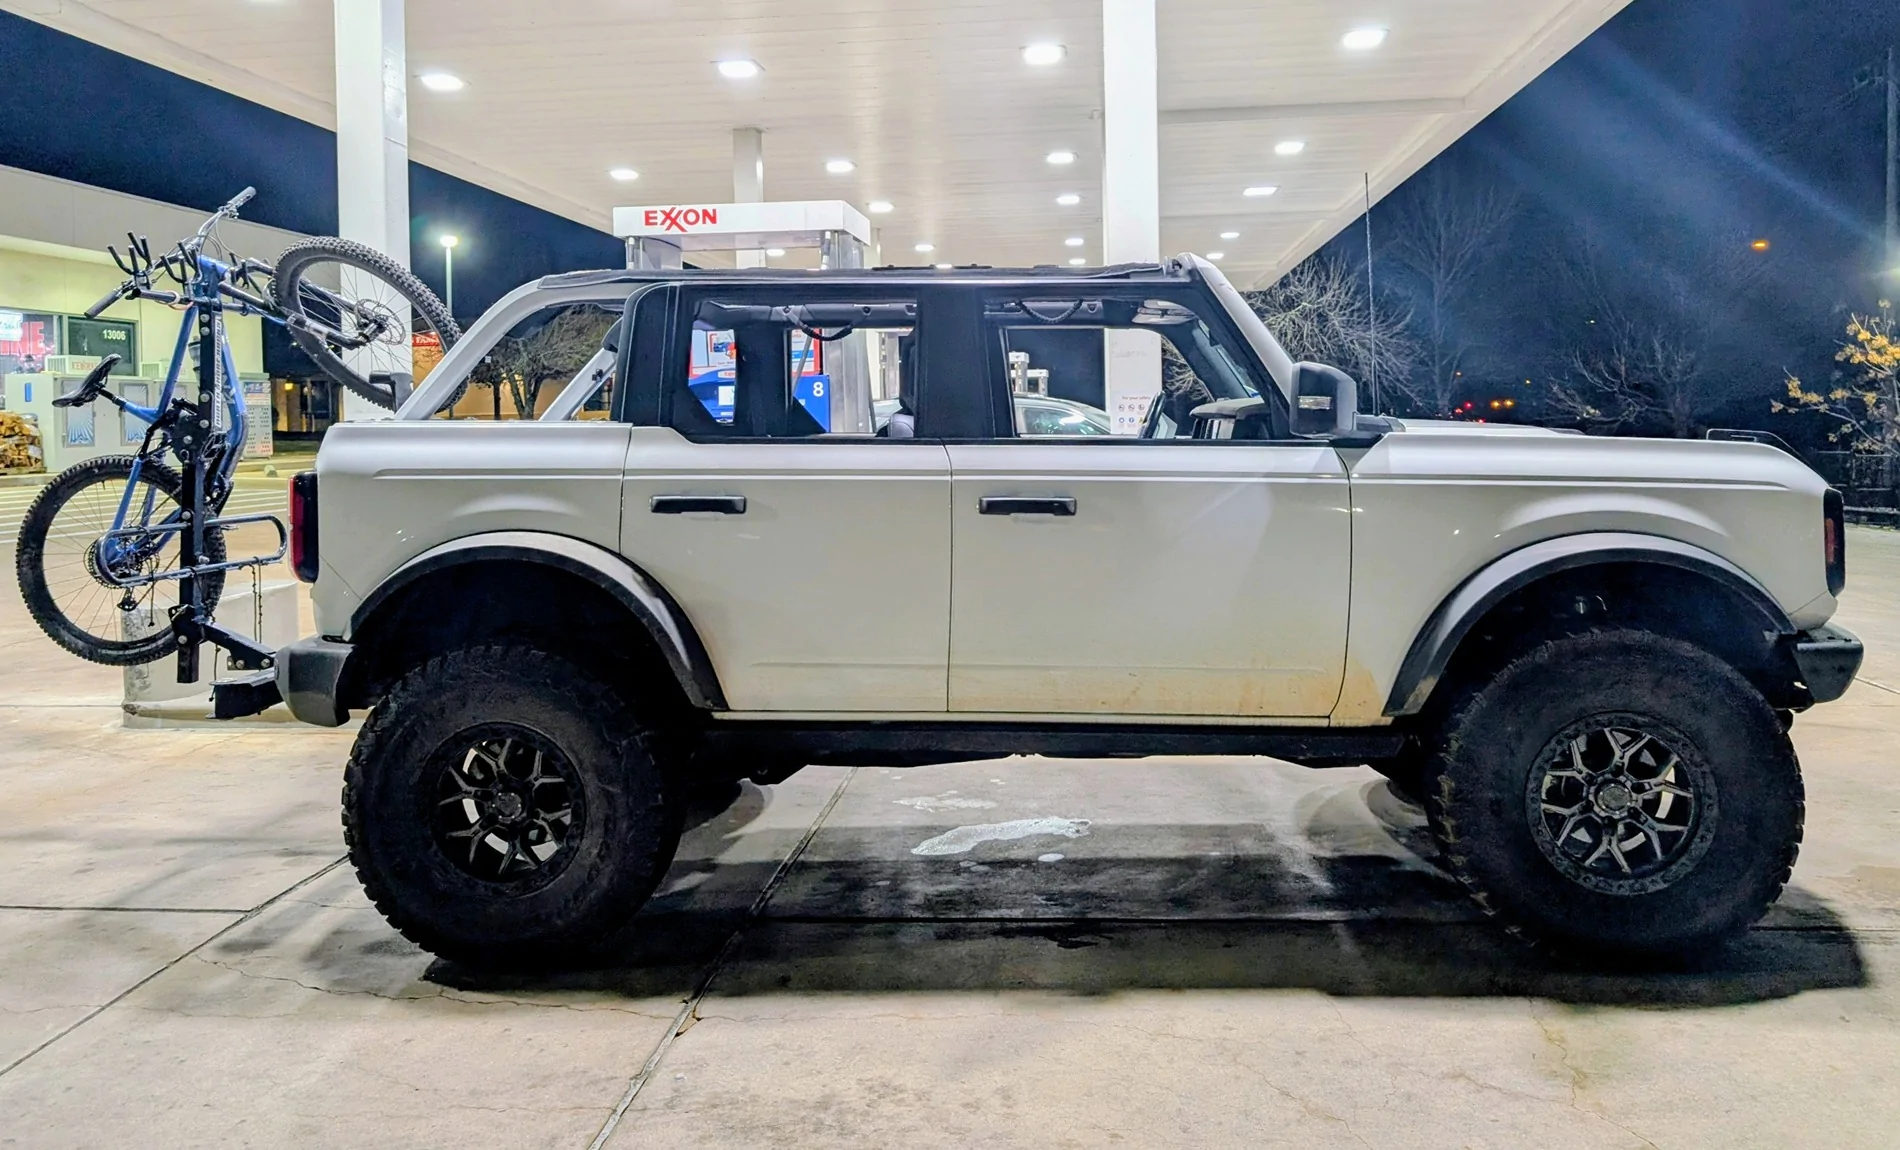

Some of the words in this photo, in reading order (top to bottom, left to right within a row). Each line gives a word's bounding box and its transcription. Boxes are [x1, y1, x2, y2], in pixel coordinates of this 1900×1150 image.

[644, 207, 717, 232] EXXON
[103, 329, 126, 340] 13006
[813, 381, 824, 398] 8
